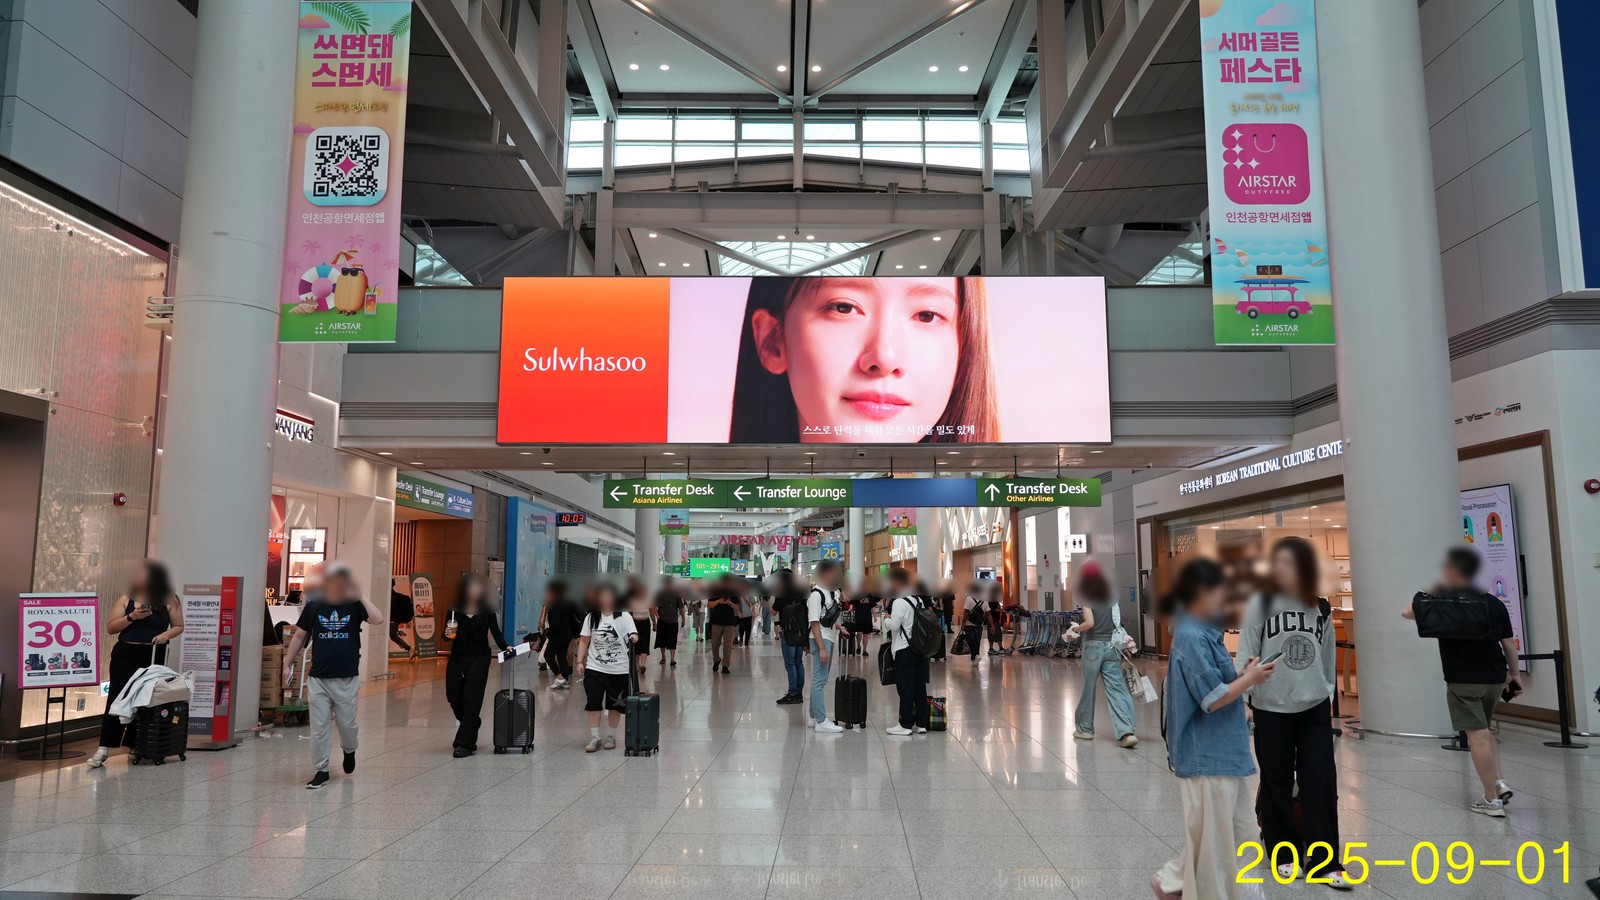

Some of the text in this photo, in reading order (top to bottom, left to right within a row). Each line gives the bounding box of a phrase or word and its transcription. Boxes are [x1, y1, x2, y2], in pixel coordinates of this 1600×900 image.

[313, 34, 394, 59] 쓰면돼
[311, 62, 392, 87] 스면세
[1219, 57, 1302, 83] 페스타
[1238, 175, 1296, 188] AIRSTAR
[302, 212, 385, 224] 인천공항면세점앱
[1226, 211, 1312, 224] 인천공항면세점앱
[328, 322, 361, 330] AIRSTAR
[1264, 324, 1299, 332] AIRSTAR
[523, 347, 646, 373] Sulwhasoo
[802, 425, 832, 435] 스스로
[910, 425, 933, 436] 시간을
[937, 425, 955, 436] 밀도
[957, 425, 975, 436] 있게
[1215, 469, 1239, 486] KOREAN
[1239, 458, 1281, 480] TRADITIONAL
[1282, 447, 1316, 468] CULTURE
[633, 484, 714, 495] Transfer Desk
[756, 486, 846, 500] Transfer Lounge
[1006, 483, 1088, 494] Transfer Desk
[1473, 501, 1497, 510] Procession
[562, 514, 585, 523] 10:03
[720, 534, 816, 546] AIRSTAR AVEUE
[823, 547, 838, 559] 26
[735, 563, 745, 571] 27
[1266, 611, 1323, 645] UCLA
[318, 631, 349, 639] adidas
